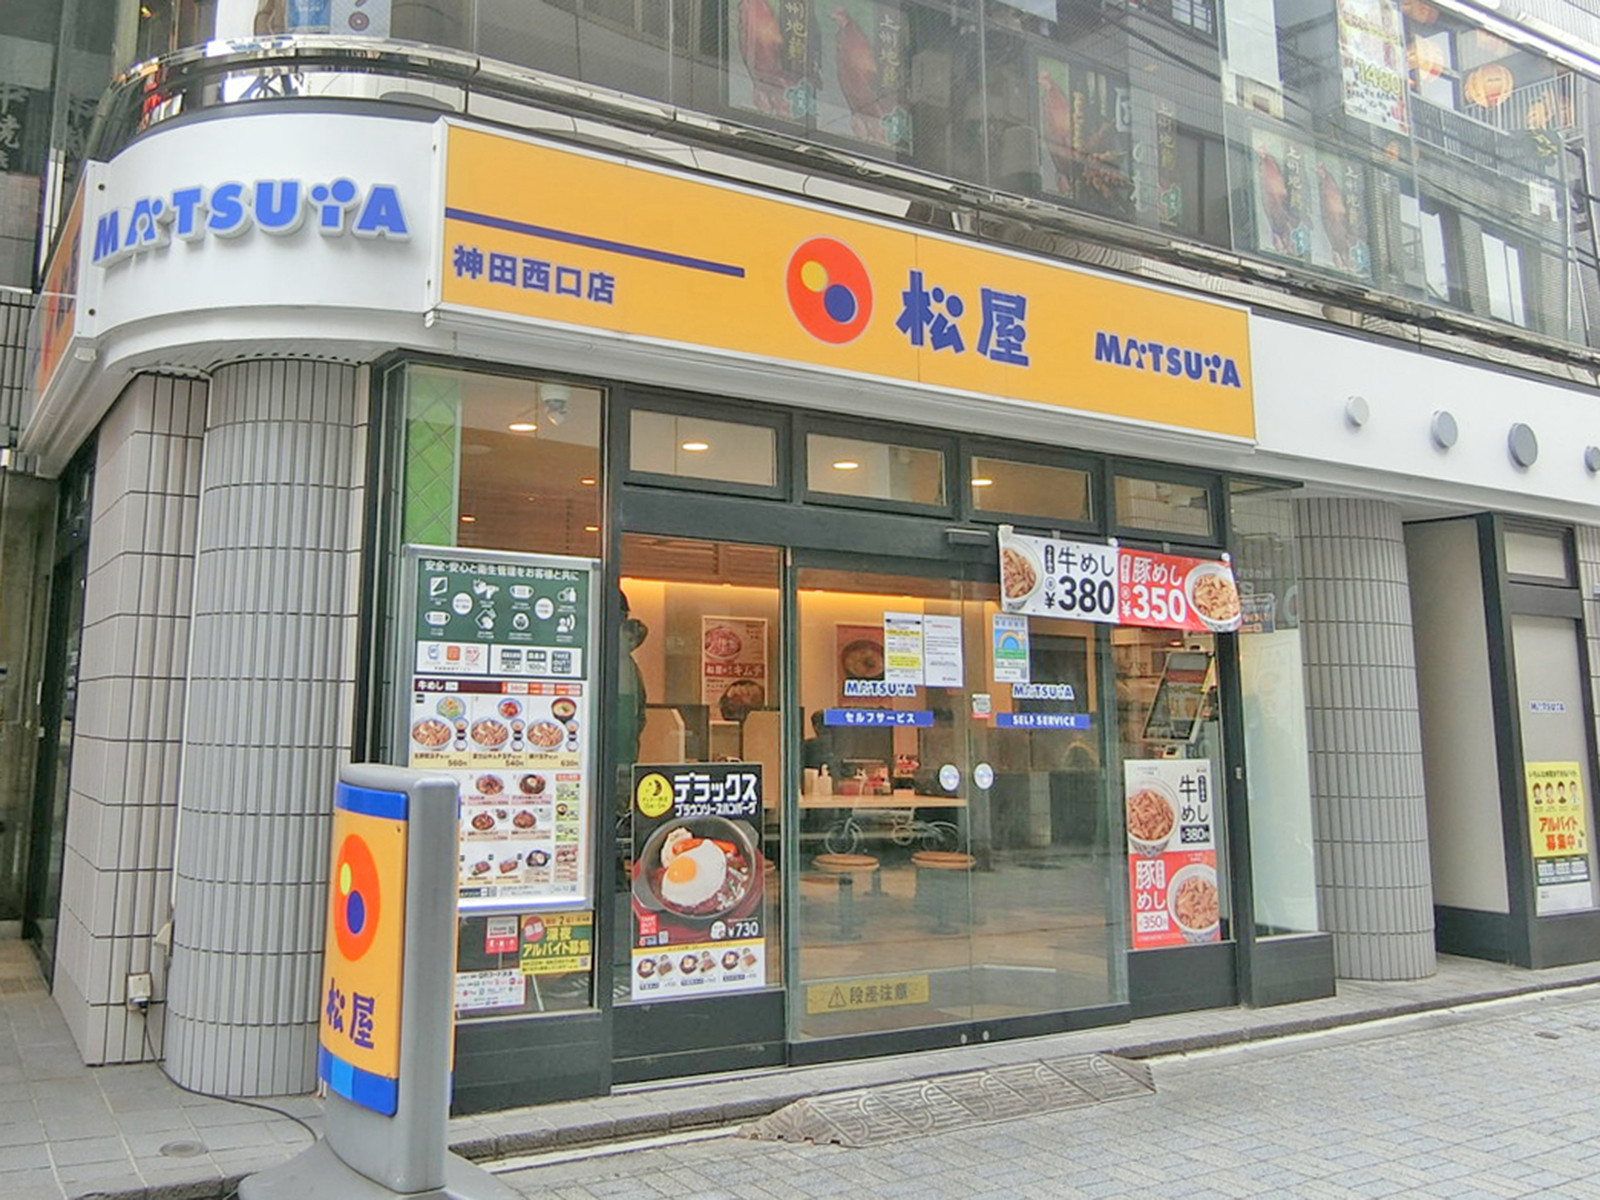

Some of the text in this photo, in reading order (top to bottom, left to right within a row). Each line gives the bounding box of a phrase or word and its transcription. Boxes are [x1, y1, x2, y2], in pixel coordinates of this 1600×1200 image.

[93, 179, 408, 263] MATSUYA
[454, 243, 615, 305] 神田西口店
[897, 271, 1030, 367] 松屋
[1095, 332, 1241, 389] MATSUYA
[1058, 546, 1115, 577] 牛めし
[1132, 556, 1182, 586] 豚めし
[1045, 575, 1115, 615] ¥380
[1121, 585, 1187, 623] ¥350
[847, 681, 915, 695] MATSUYA
[1014, 684, 1073, 698] MATSUYA
[845, 712, 916, 724] セルフサービス
[1013, 714, 1076, 726] SELF SERVICE
[674, 772, 758, 803] デラックス
[1539, 816, 1578, 832] アルバイト
[1546, 833, 1576, 851] 募集中
[728, 921, 759, 938] ¥730
[522, 940, 590, 957] アルバイト募集
[849, 982, 909, 1004] 段差注意
[325, 977, 374, 1049] 松屋
